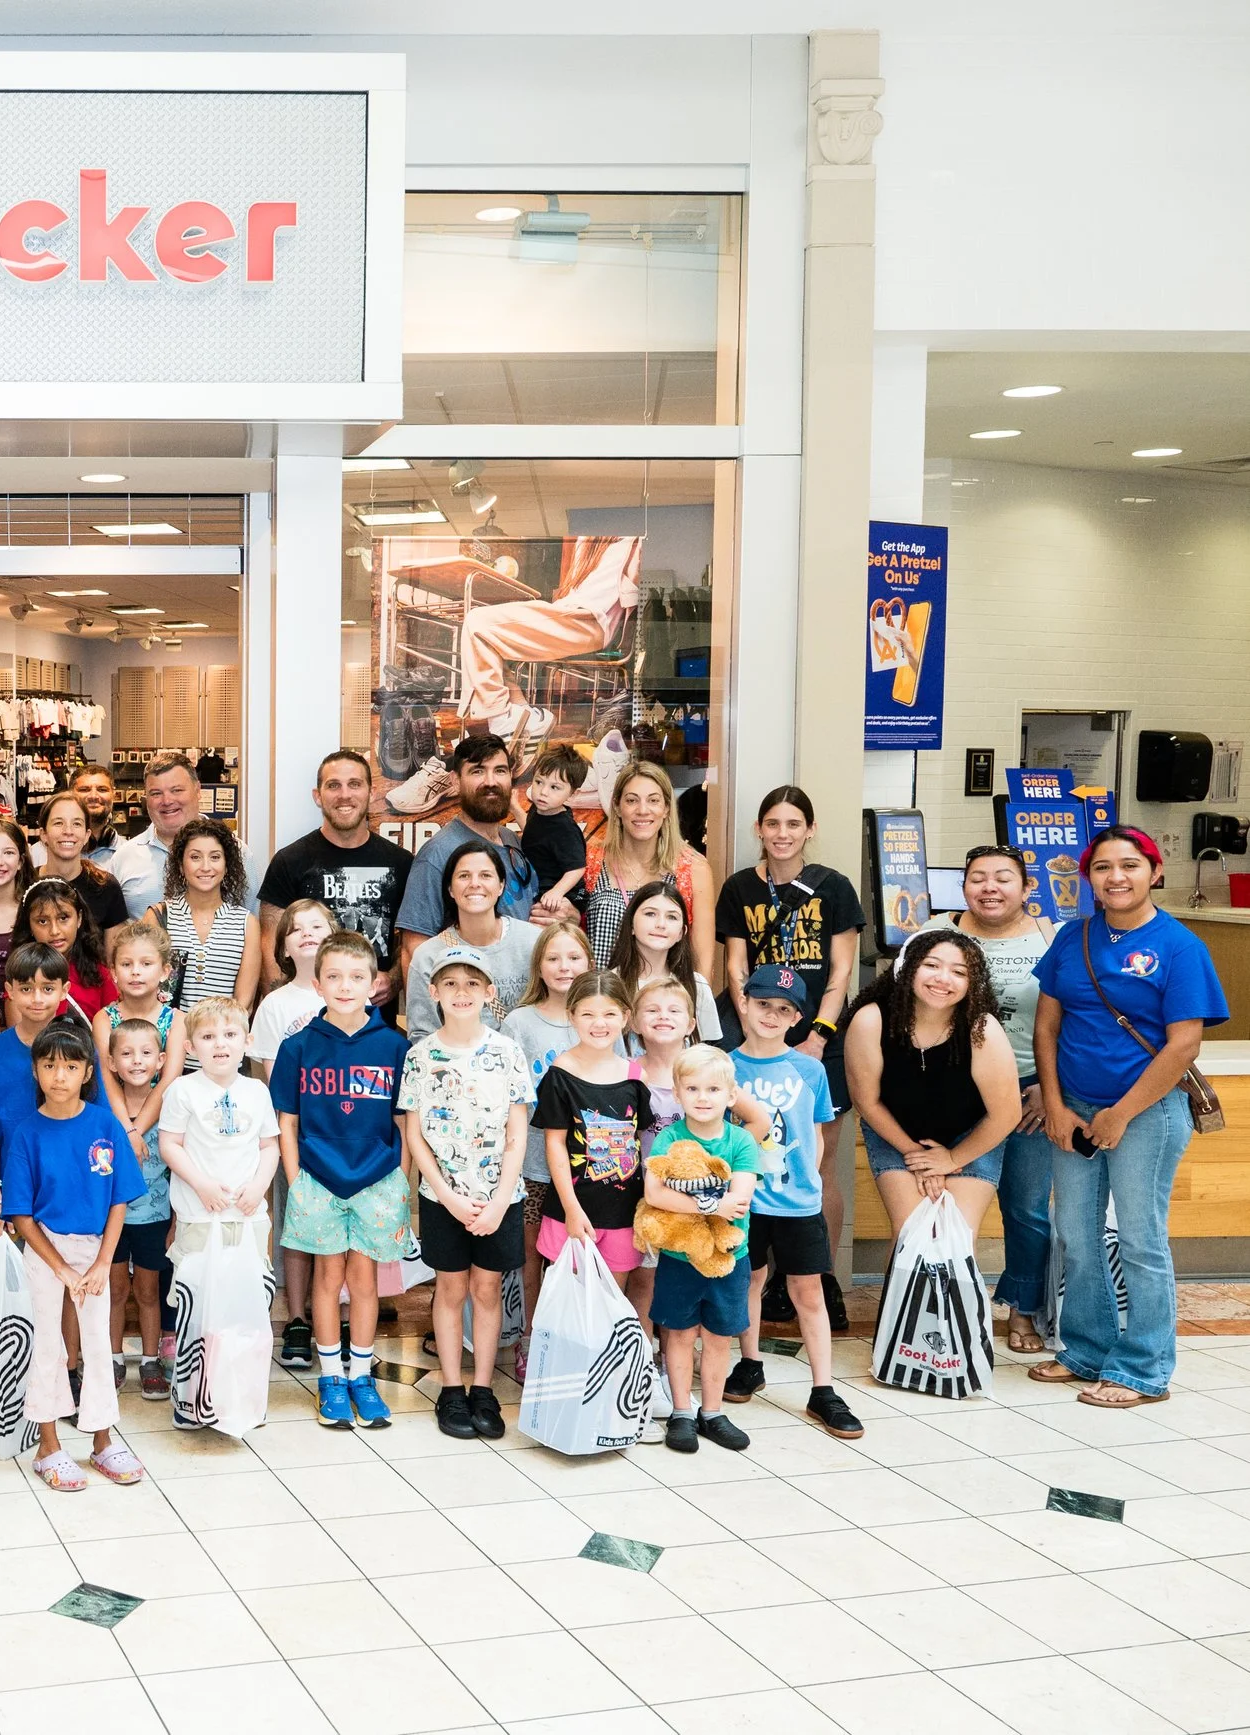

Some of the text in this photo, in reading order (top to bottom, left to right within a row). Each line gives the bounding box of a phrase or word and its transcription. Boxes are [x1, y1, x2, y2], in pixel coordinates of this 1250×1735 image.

[882, 540, 926, 556] Get the App
[889, 553, 899, 567] A
[901, 554, 941, 570] Pretzel
[885, 569, 902, 584] On
[1022, 779, 1059, 787] ORDER
[1024, 787, 1062, 799] HERE
[1015, 812, 1076, 826] ORDER
[883, 831, 918, 841] PRETZELS
[1016, 827, 1079, 845] HERE
[883, 842, 893, 852] SO
[890, 853, 915, 864] HANDS
[885, 864, 895, 875] SO
[323, 874, 382, 899] BEATLES
[777, 969, 794, 988] B
[742, 1077, 804, 1113] LUEY
[899, 1344, 961, 1369] Foot Locker
[598, 1436, 613, 1446] Kids
